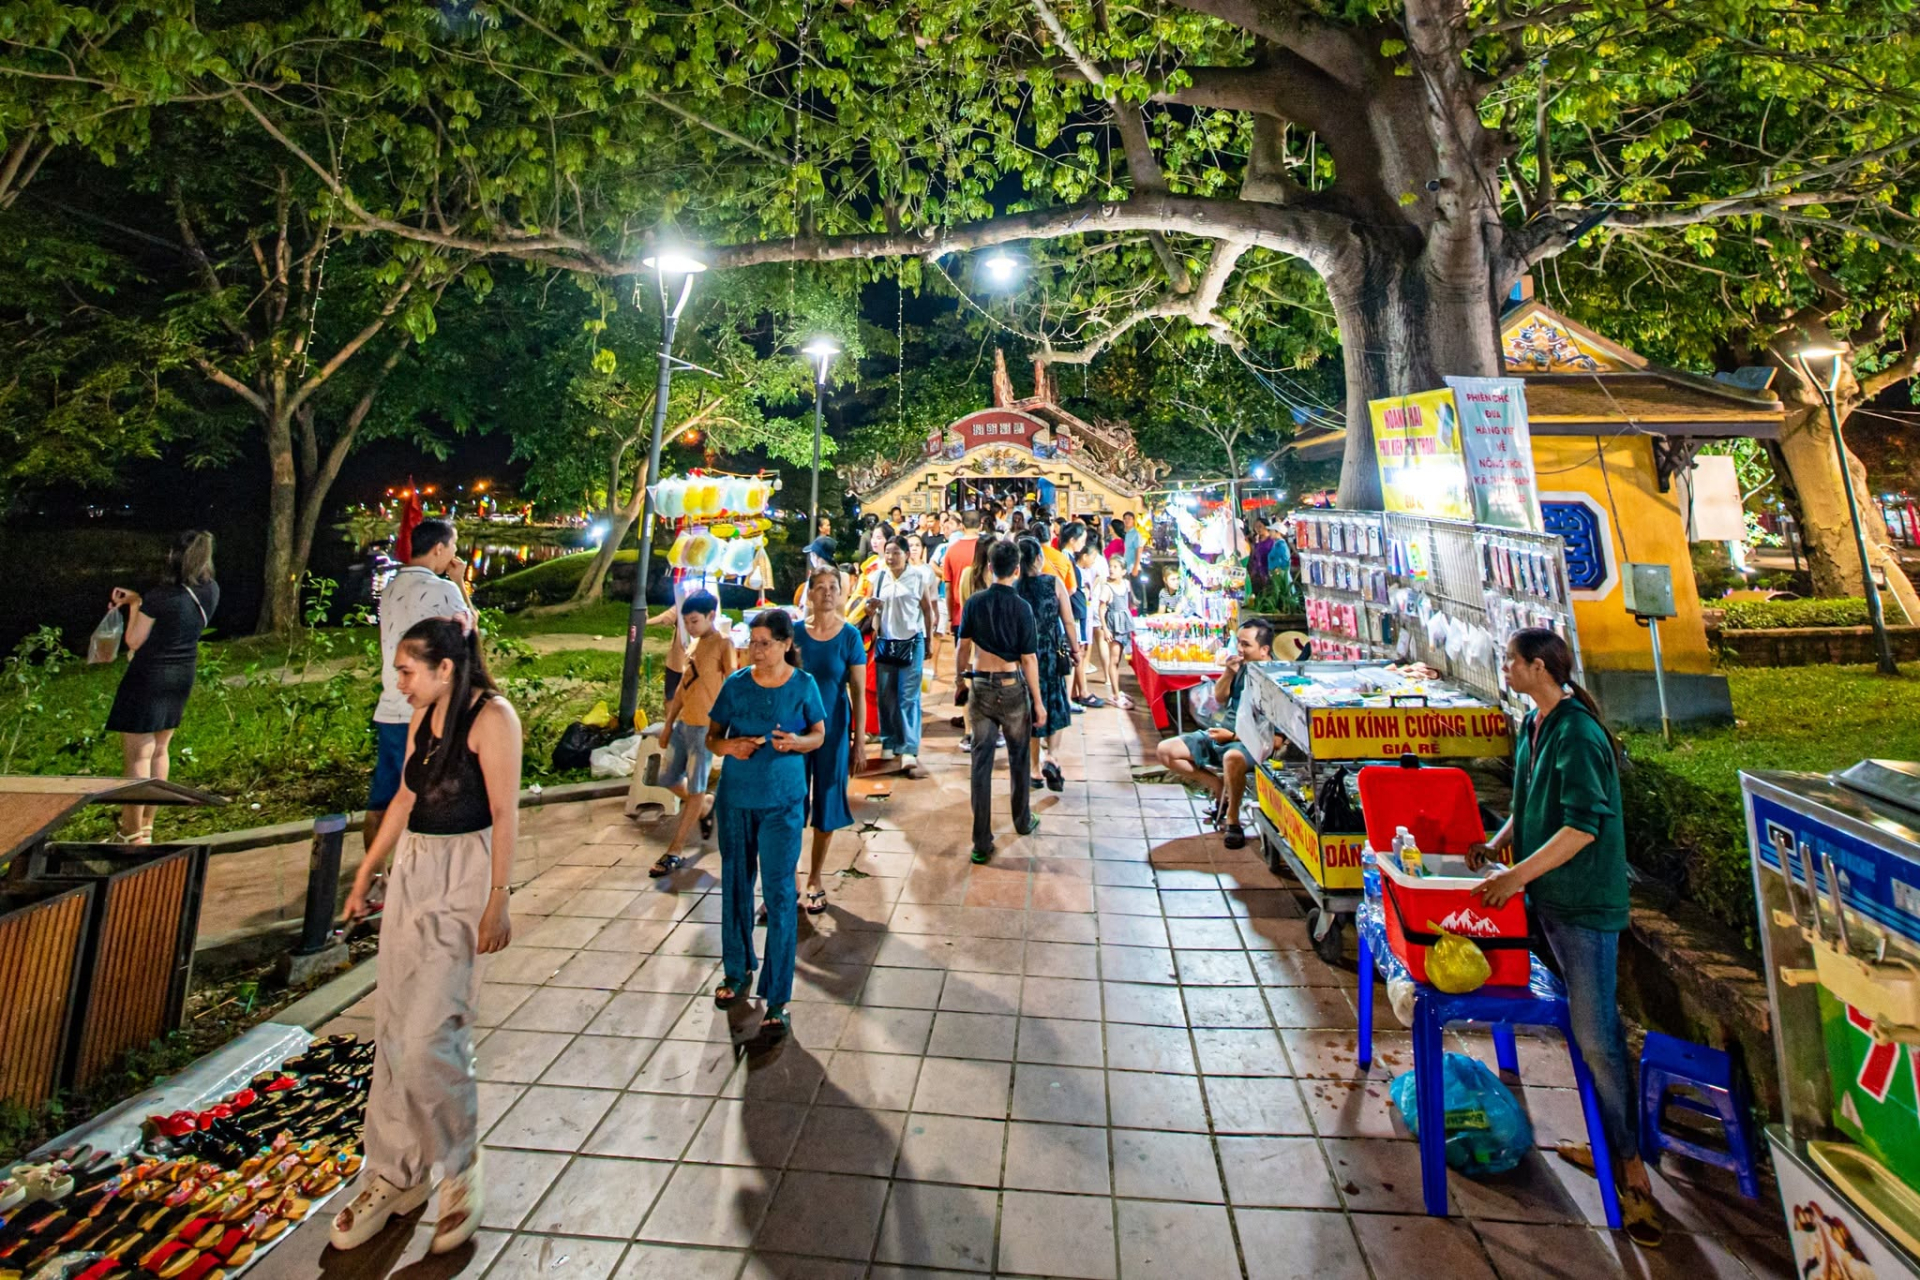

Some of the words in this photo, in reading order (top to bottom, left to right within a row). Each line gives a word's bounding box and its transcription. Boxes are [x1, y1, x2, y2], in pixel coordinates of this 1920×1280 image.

[1312, 712, 1350, 738] DÁN
[1355, 711, 1400, 738] KÍNH
[1405, 710, 1467, 738] CƯỜNG
[1472, 714, 1507, 742] LỰC
[1382, 742, 1412, 754] GIÁ
[1419, 741, 1441, 754] RẺ
[1325, 839, 1362, 867] DÁN
